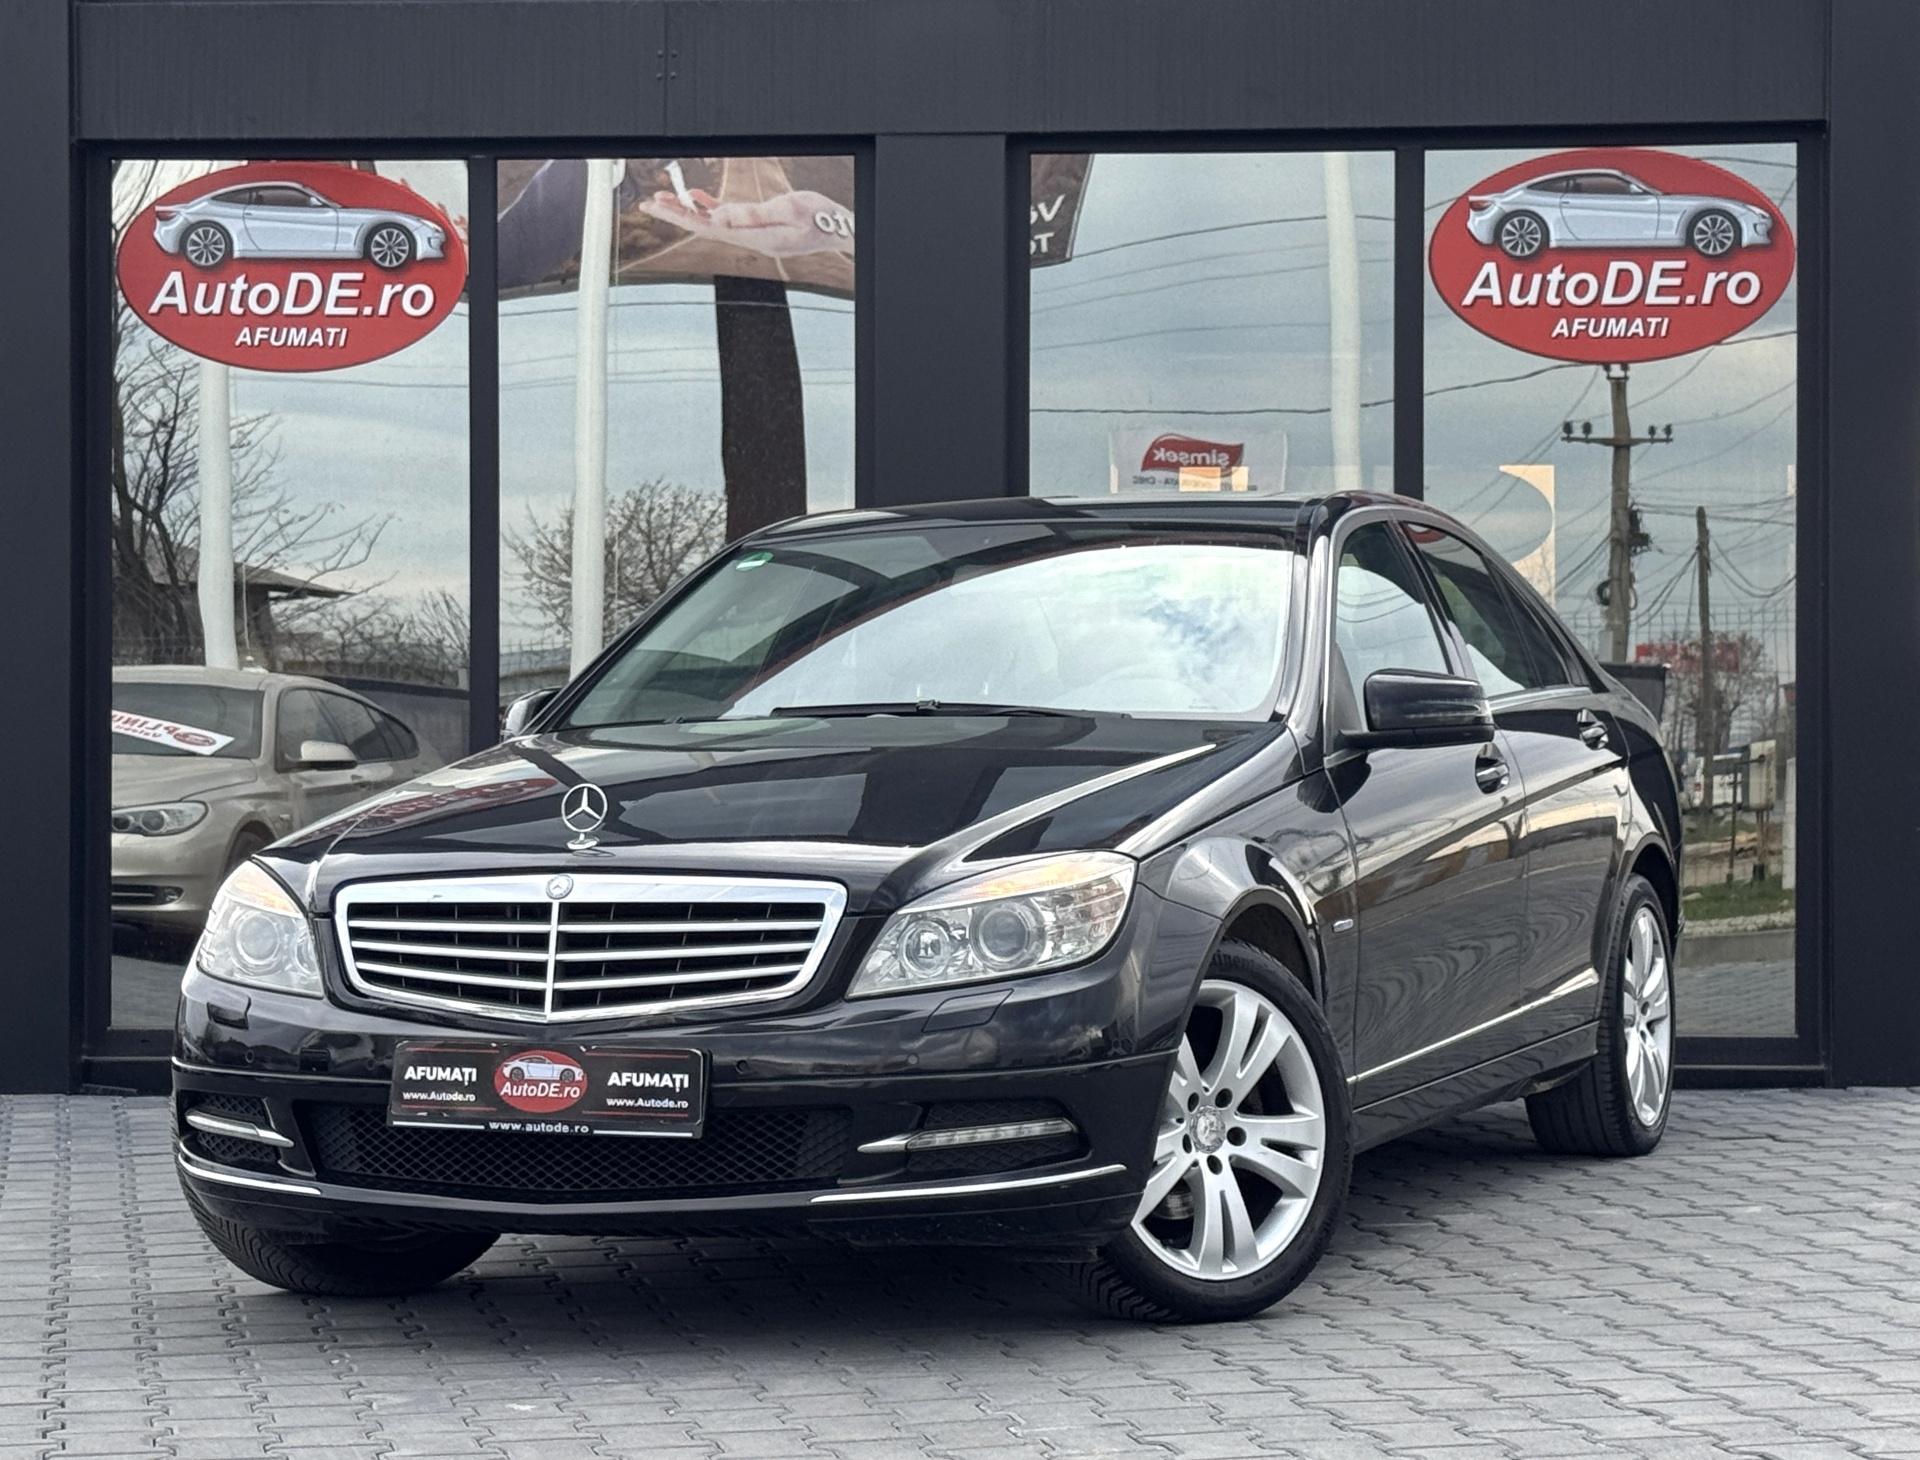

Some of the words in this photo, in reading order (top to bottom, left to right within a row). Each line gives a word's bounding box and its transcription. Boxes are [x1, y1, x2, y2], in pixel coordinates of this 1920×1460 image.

[1461, 260, 1761, 308] AutoDE.ro
[148, 270, 436, 318] AutoDE.ro
[234, 326, 348, 348] AFUMATI
[1551, 317, 1670, 338] AFUMATI
[402, 1090, 476, 1102] www.Autode.ro
[500, 1081, 581, 1099] AutoDE.ro
[606, 1097, 689, 1109] www.Autode.ro
[488, 1120, 589, 1134] www.autode.ro
